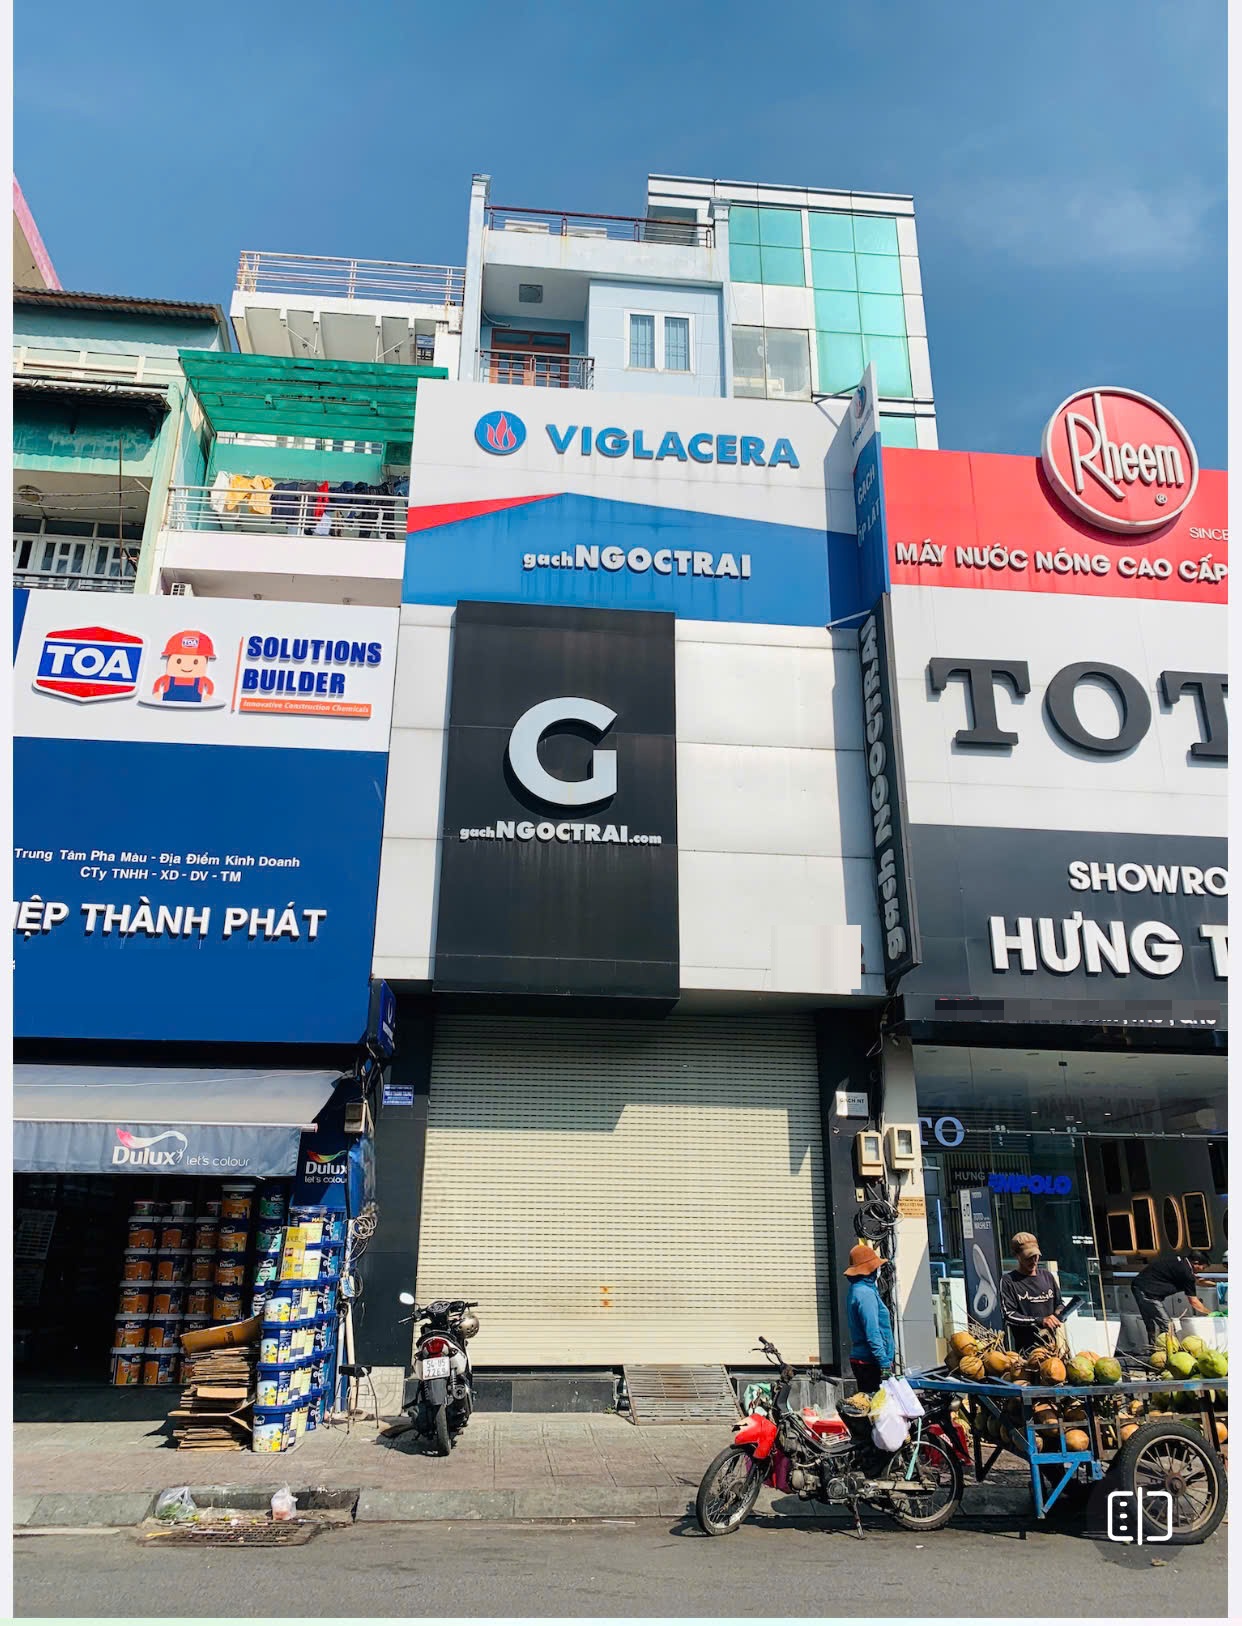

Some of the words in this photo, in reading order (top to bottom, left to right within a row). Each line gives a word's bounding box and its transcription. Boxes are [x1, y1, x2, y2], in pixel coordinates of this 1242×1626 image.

[546, 424, 800, 467] VIGLACERA
[1065, 392, 1185, 500] Rheem
[1189, 527, 1228, 541] SINCE
[523, 544, 751, 578] gachNGOCTRAI
[895, 538, 947, 565] MÁY
[956, 542, 1028, 570] NƯỚC
[1035, 548, 1111, 574] NÓNG
[1118, 556, 1172, 579] CAO
[1179, 553, 1228, 582] CẤP
[45, 644, 134, 679] TOA
[247, 636, 382, 665] SOLUTIONS
[242, 668, 346, 695] BUILDER
[243, 700, 283, 709] Innovative
[284, 702, 330, 711] Construction
[331, 704, 369, 713] Chemicals
[929, 657, 1228, 757] TOT
[509, 697, 618, 805] G
[460, 821, 662, 844] gachNGOCTRAI.com
[14, 848, 53, 861] Trung
[60, 850, 86, 860] Tâm
[91, 851, 115, 861] Pha
[120, 852, 147, 863] Màu
[159, 853, 181, 866] Địa
[186, 852, 219, 865] Điểm
[225, 855, 254, 866] Kinh
[259, 856, 300, 868] Doanh
[80, 866, 107, 881] CTy
[111, 868, 149, 879] TNHH
[160, 870, 179, 880] XD
[190, 870, 208, 881] DV
[220, 871, 241, 882] TM
[1068, 861, 1228, 895] SHOWRO
[81, 896, 211, 934] THÀNH
[223, 901, 328, 937] PHÁT
[989, 912, 1183, 976] HƯNG
[112, 1146, 176, 1165] Dulux
[187, 1155, 209, 1166] let's
[212, 1156, 250, 1167] colour
[304, 1175, 322, 1184] let's
